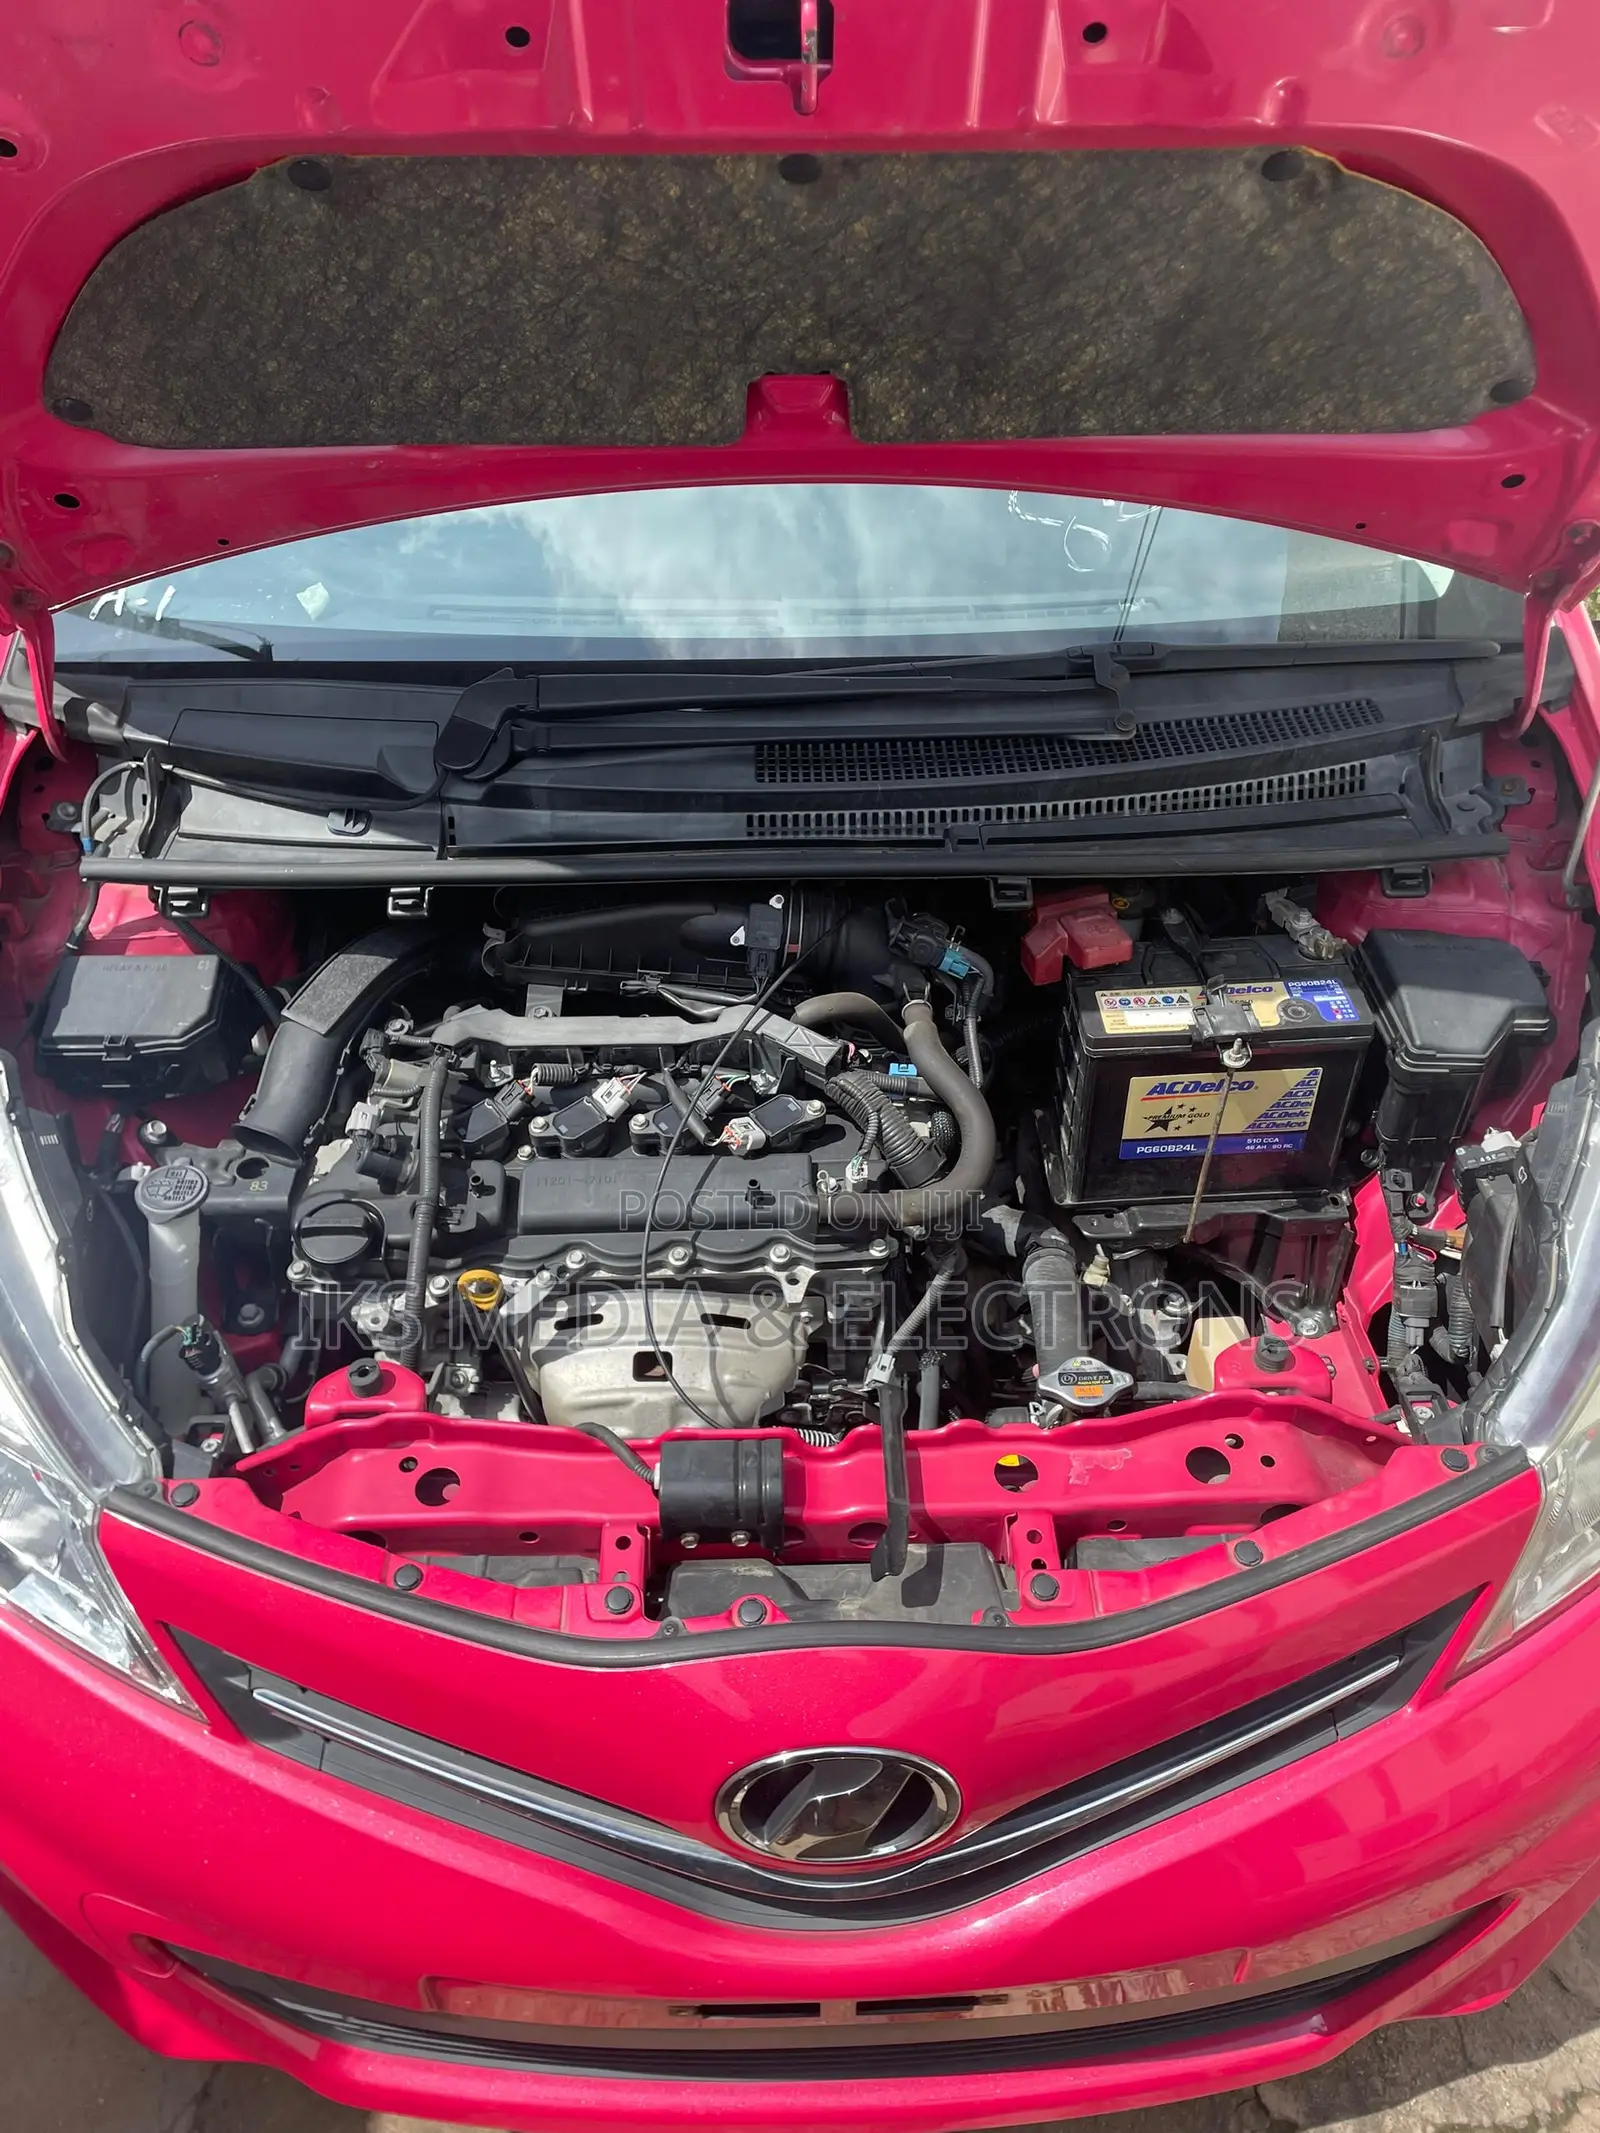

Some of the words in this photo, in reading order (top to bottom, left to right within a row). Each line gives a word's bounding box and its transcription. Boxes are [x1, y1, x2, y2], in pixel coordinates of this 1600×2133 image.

[1245, 1120, 1307, 1129] ACDelco
[1136, 1144, 1198, 1154] PG60B24L
[249, 1181, 268, 1191] 83
